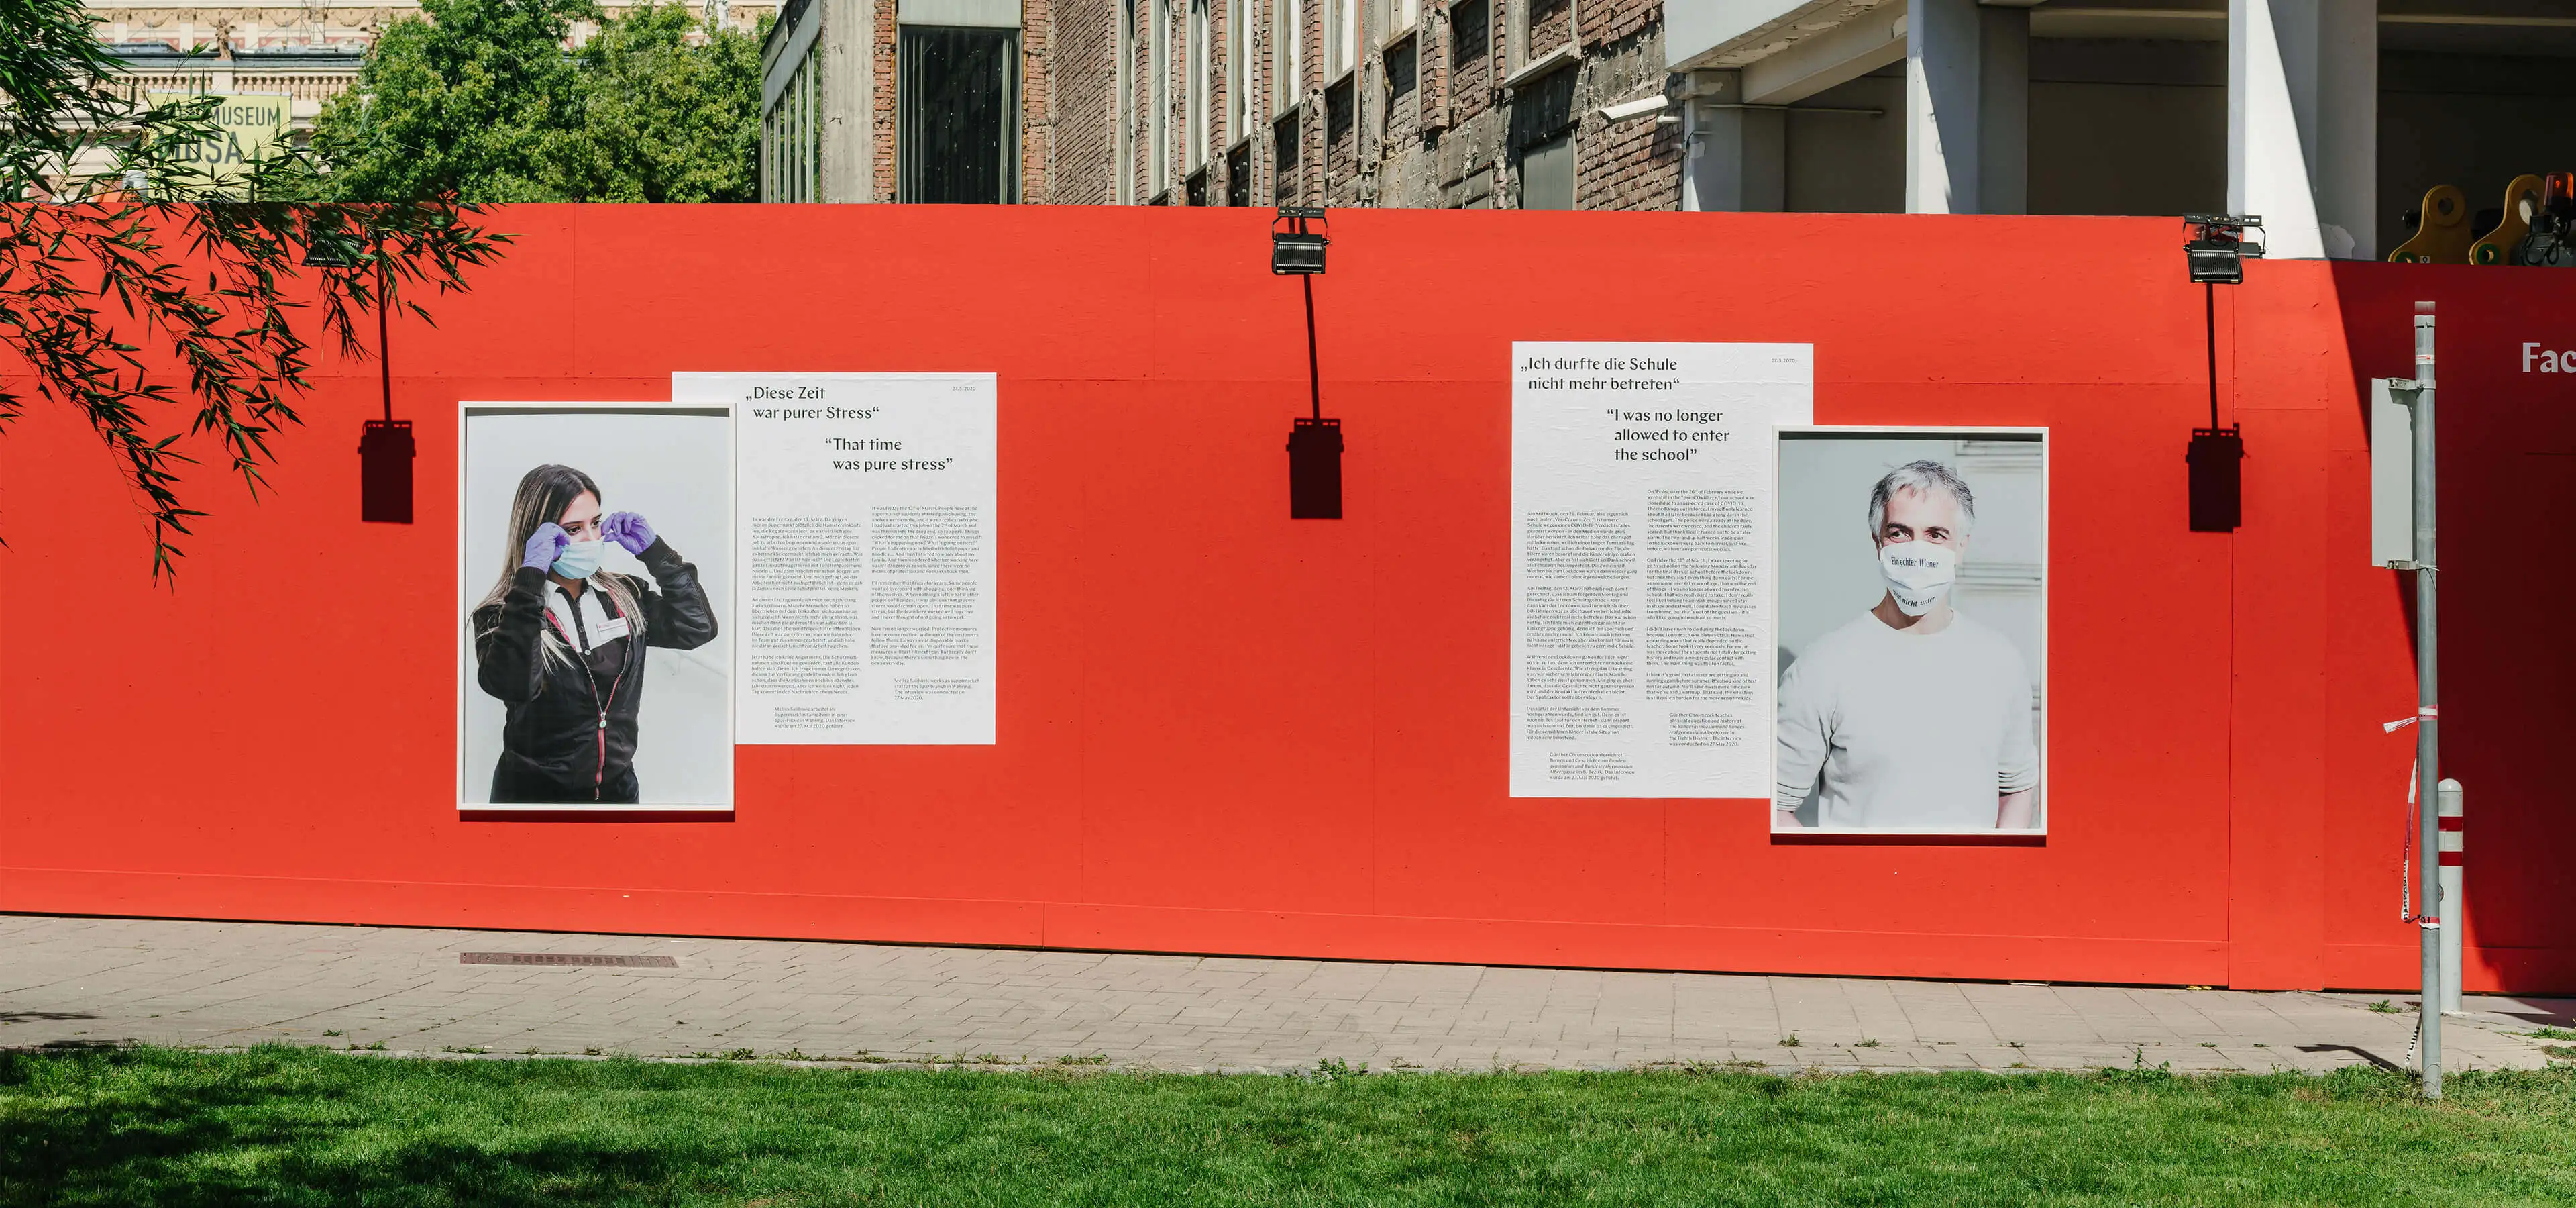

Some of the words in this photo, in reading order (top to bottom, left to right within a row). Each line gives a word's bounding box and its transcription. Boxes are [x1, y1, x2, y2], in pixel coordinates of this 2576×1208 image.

[210, 107, 278, 126] MUSEUM
[1521, 357, 1550, 372] „Ich
[1554, 357, 1600, 370] durfte
[1604, 357, 1625, 370] die
[1629, 358, 1677, 370] Schule
[1529, 376, 1565, 390] nicht
[1569, 377, 1607, 390] mehr
[1611, 377, 1680, 390] betreten“
[745, 387, 794, 401] „Diese
[798, 387, 826, 399] Zeit
[753, 409, 780, 419] war
[784, 409, 822, 421] purer
[826, 406, 879, 419] Stress“
[1607, 409, 1619, 421] “I
[1623, 412, 1651, 421] was
[1654, 412, 1672, 421] no
[1676, 409, 1723, 425] longer
[1615, 428, 1668, 441] allowed
[1672, 430, 1688, 442] to
[1691, 430, 1730, 442] enter
[825, 438, 865, 450] “That
[869, 438, 902, 451] time
[1614, 448, 1638, 461] the
[1642, 448, 1697, 461] school”
[833, 460, 860, 470] was
[864, 460, 897, 473] pure
[901, 458, 953, 470] stress”
